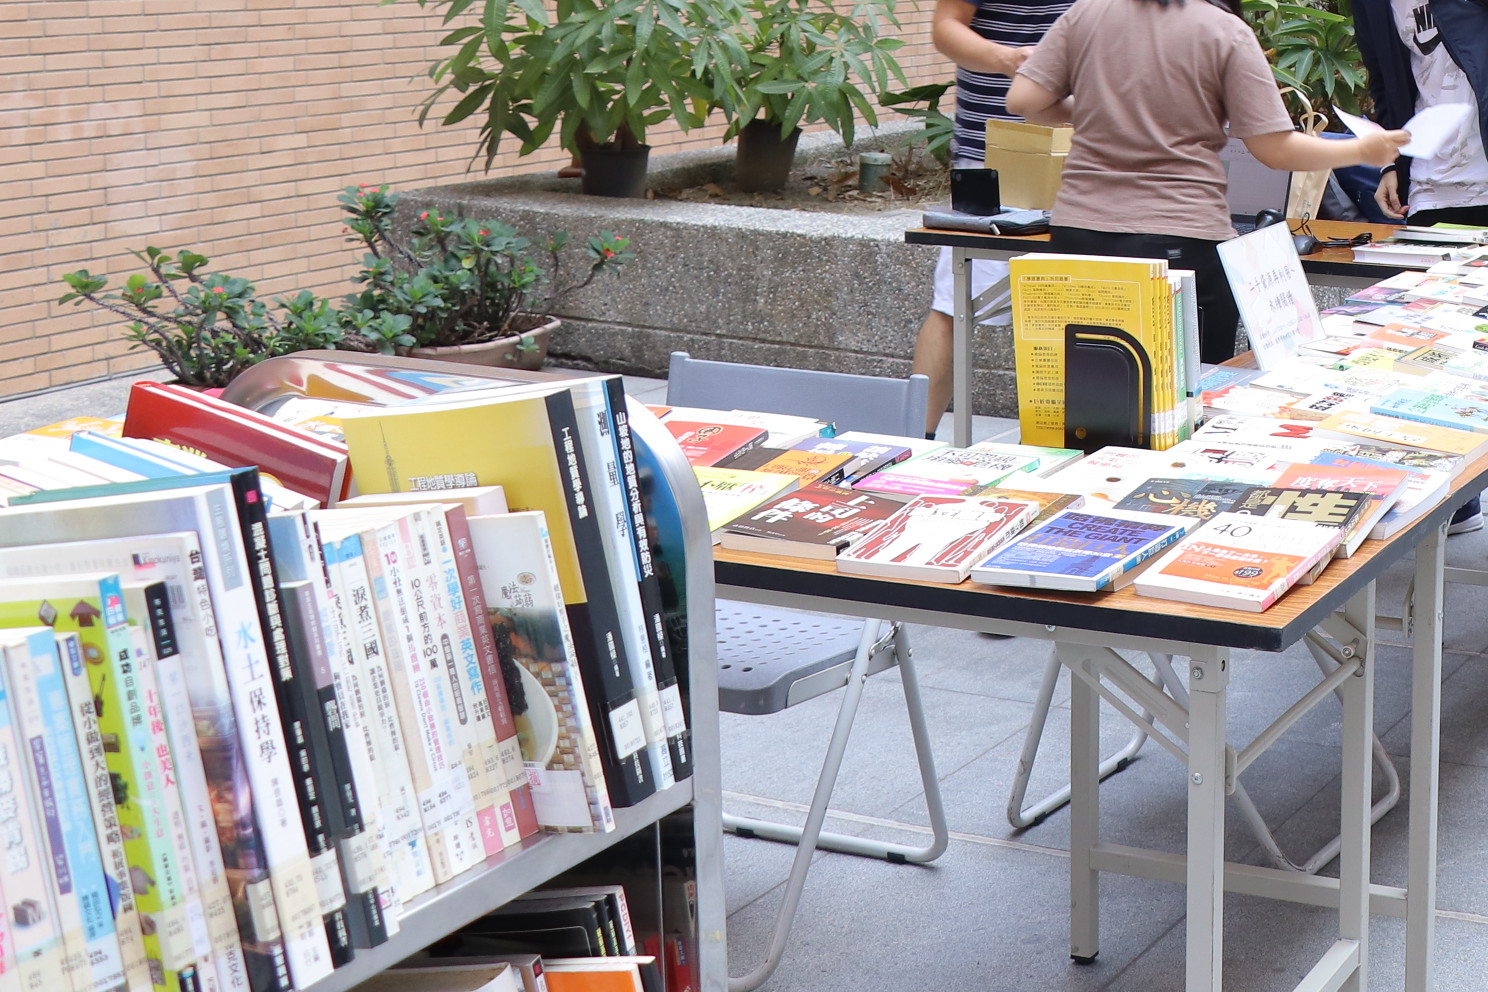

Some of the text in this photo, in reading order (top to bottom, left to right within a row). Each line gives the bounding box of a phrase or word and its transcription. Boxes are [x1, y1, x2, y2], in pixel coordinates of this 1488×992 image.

[1045, 526, 1150, 545] THE GIANT
[1067, 521, 1145, 537] CREATE
[1213, 523, 1252, 538] 40
[351, 585, 380, 661] 淚煮三國
[234, 620, 278, 765] 水土保持學
